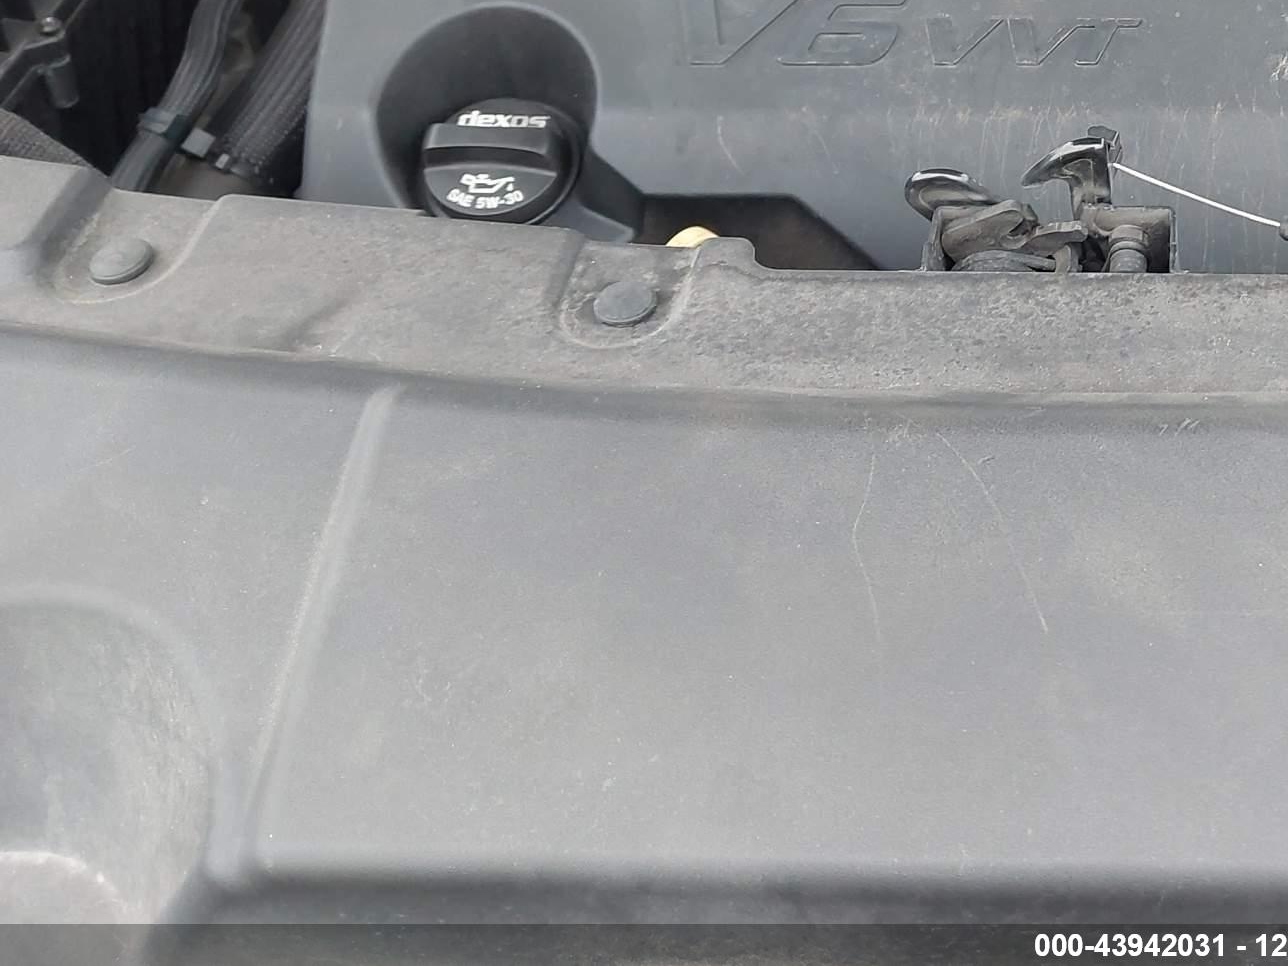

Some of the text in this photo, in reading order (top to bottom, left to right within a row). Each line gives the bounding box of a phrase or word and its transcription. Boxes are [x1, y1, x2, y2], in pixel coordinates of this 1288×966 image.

[926, 18, 1144, 67] VVT
[456, 109, 551, 128] dexos
[446, 188, 525, 210] SAE 5W-30
